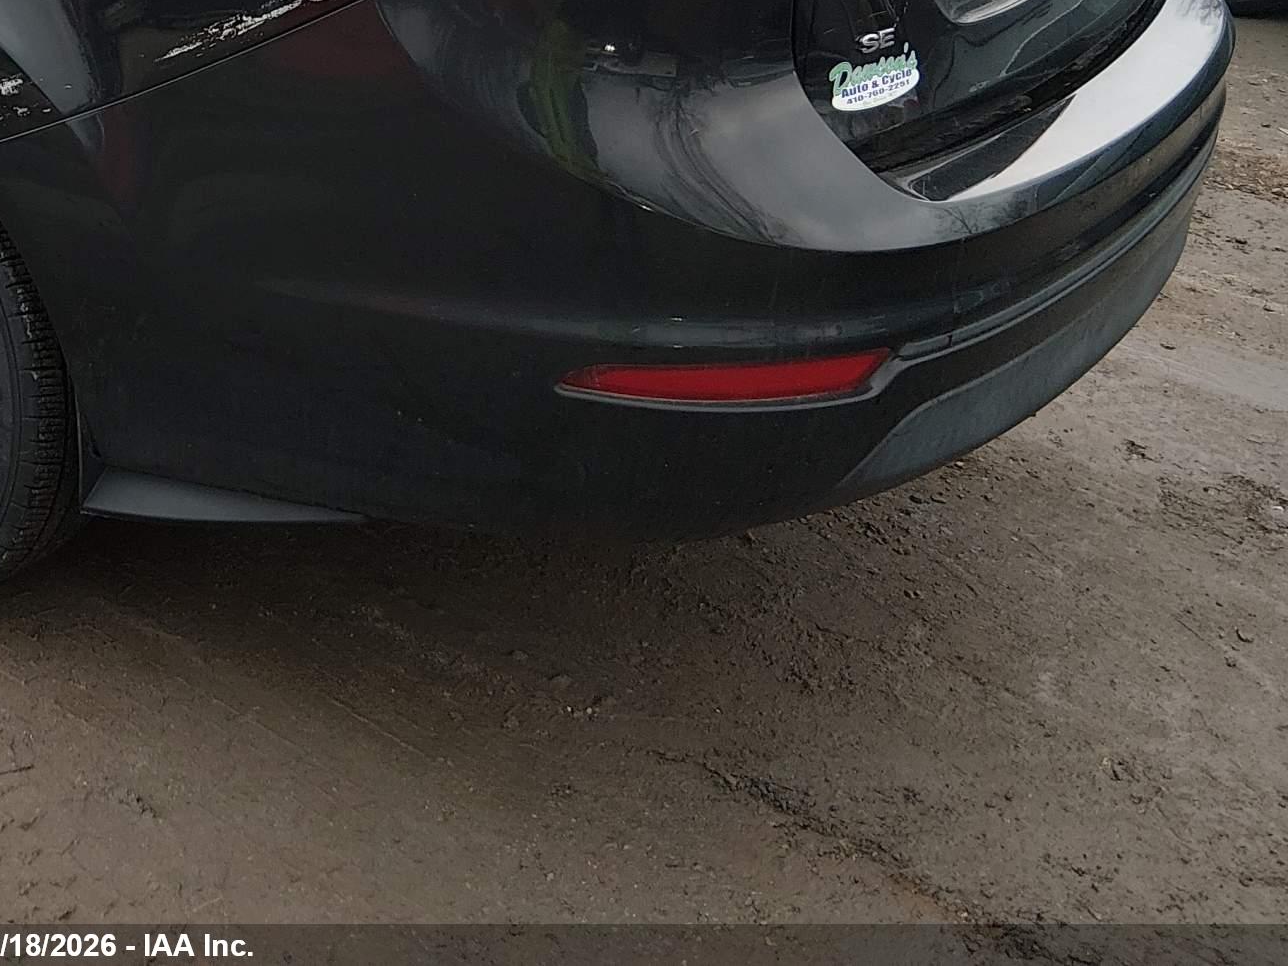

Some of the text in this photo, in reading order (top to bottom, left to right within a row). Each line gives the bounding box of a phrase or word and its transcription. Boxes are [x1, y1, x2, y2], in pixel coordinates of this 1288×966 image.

[860, 27, 895, 54] SE
[841, 83, 869, 98] Auto
[872, 80, 880, 89] &
[881, 68, 912, 84] Cycle
